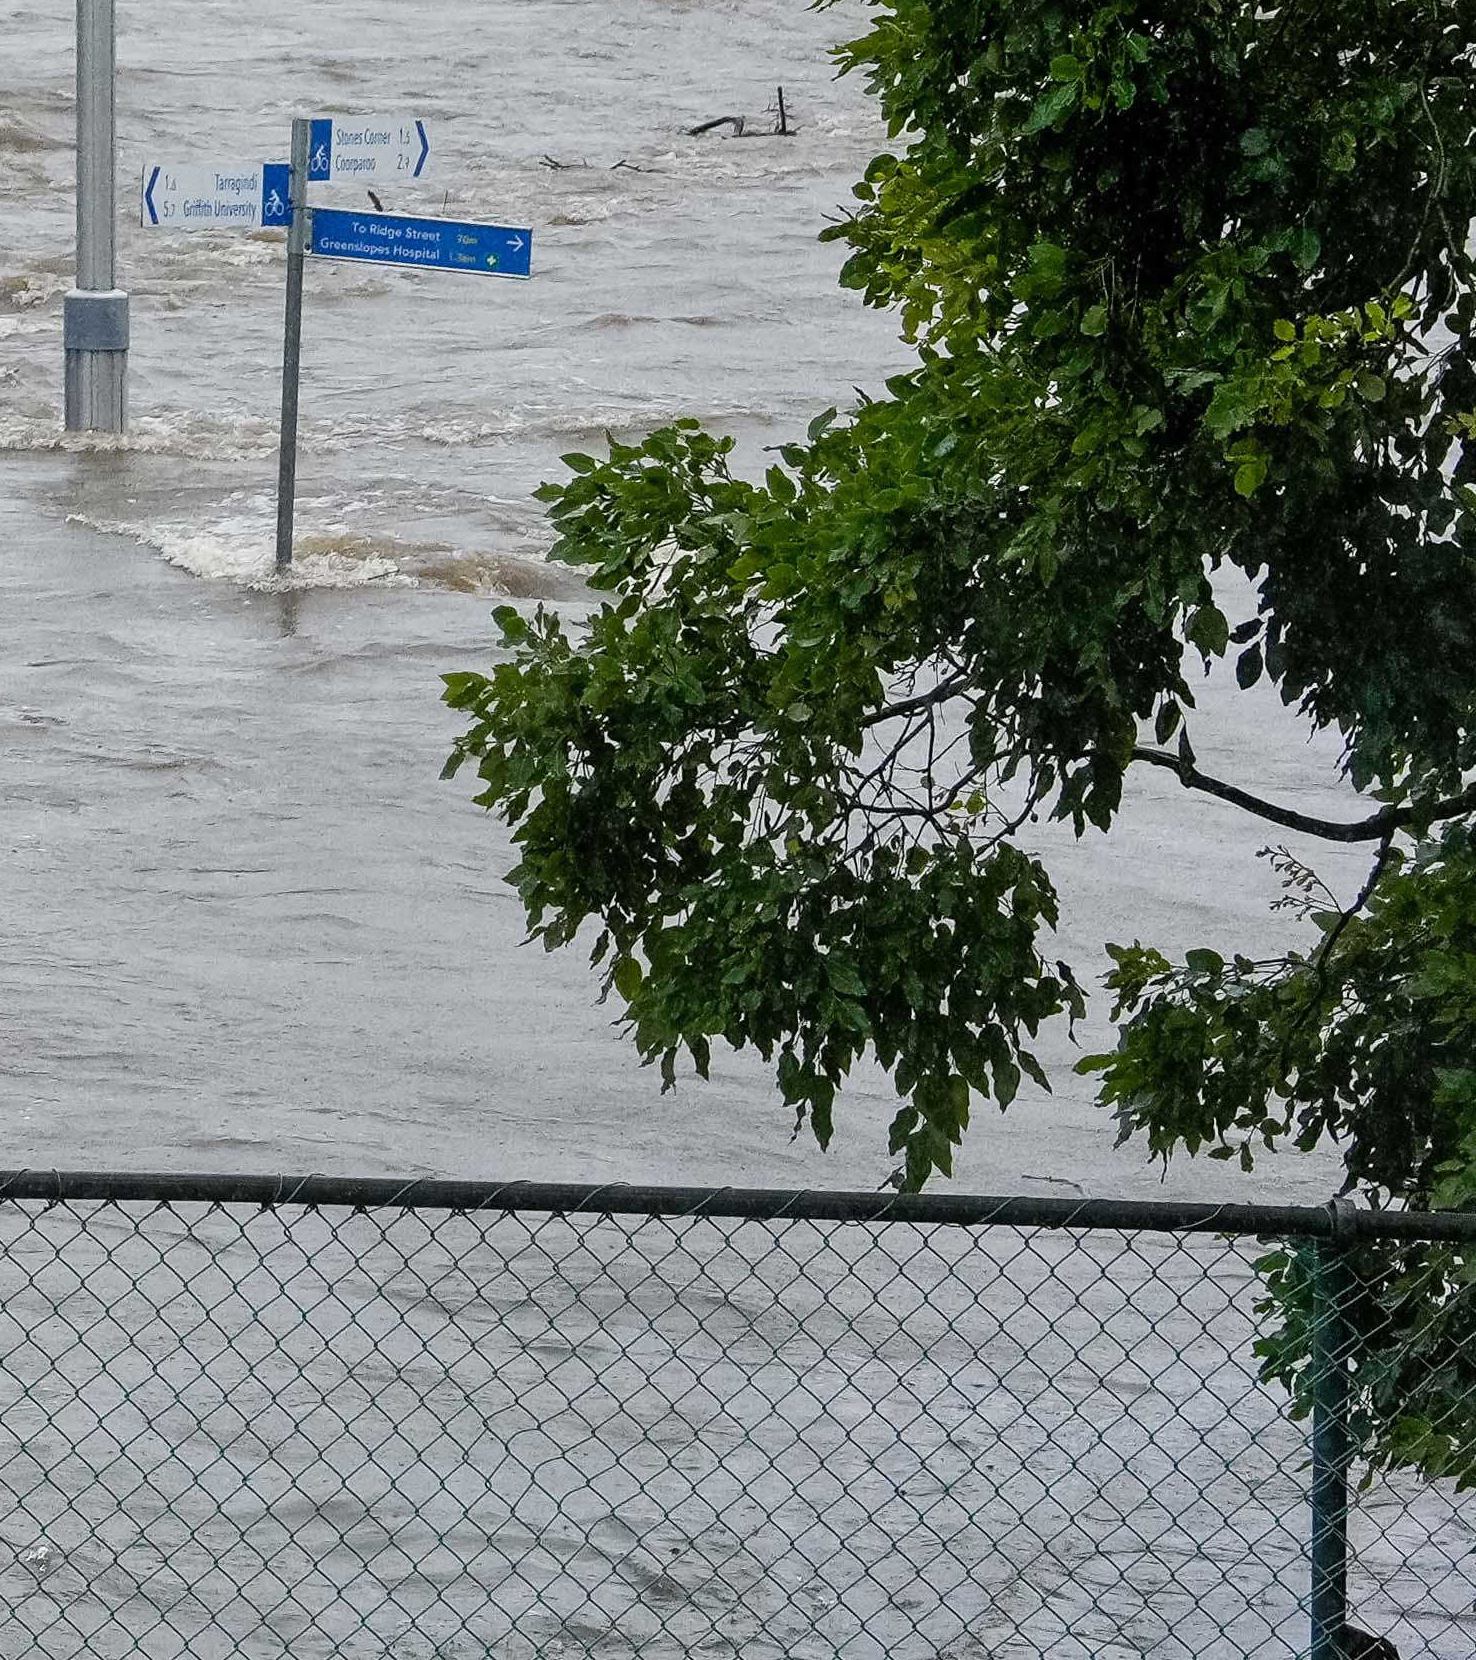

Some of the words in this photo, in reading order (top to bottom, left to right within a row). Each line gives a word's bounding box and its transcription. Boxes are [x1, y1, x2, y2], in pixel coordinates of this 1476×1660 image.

[336, 128, 363, 146] Stones
[364, 128, 391, 145] Corner
[335, 154, 376, 176] Coorparoo
[215, 172, 259, 195] Tarragindi
[183, 199, 212, 217] Griffith
[214, 199, 257, 222] University
[352, 221, 367, 233] To
[370, 224, 402, 240] Ridge
[405, 227, 441, 242] Street
[320, 237, 390, 256] Greenslopes
[393, 245, 440, 260] Hospital
